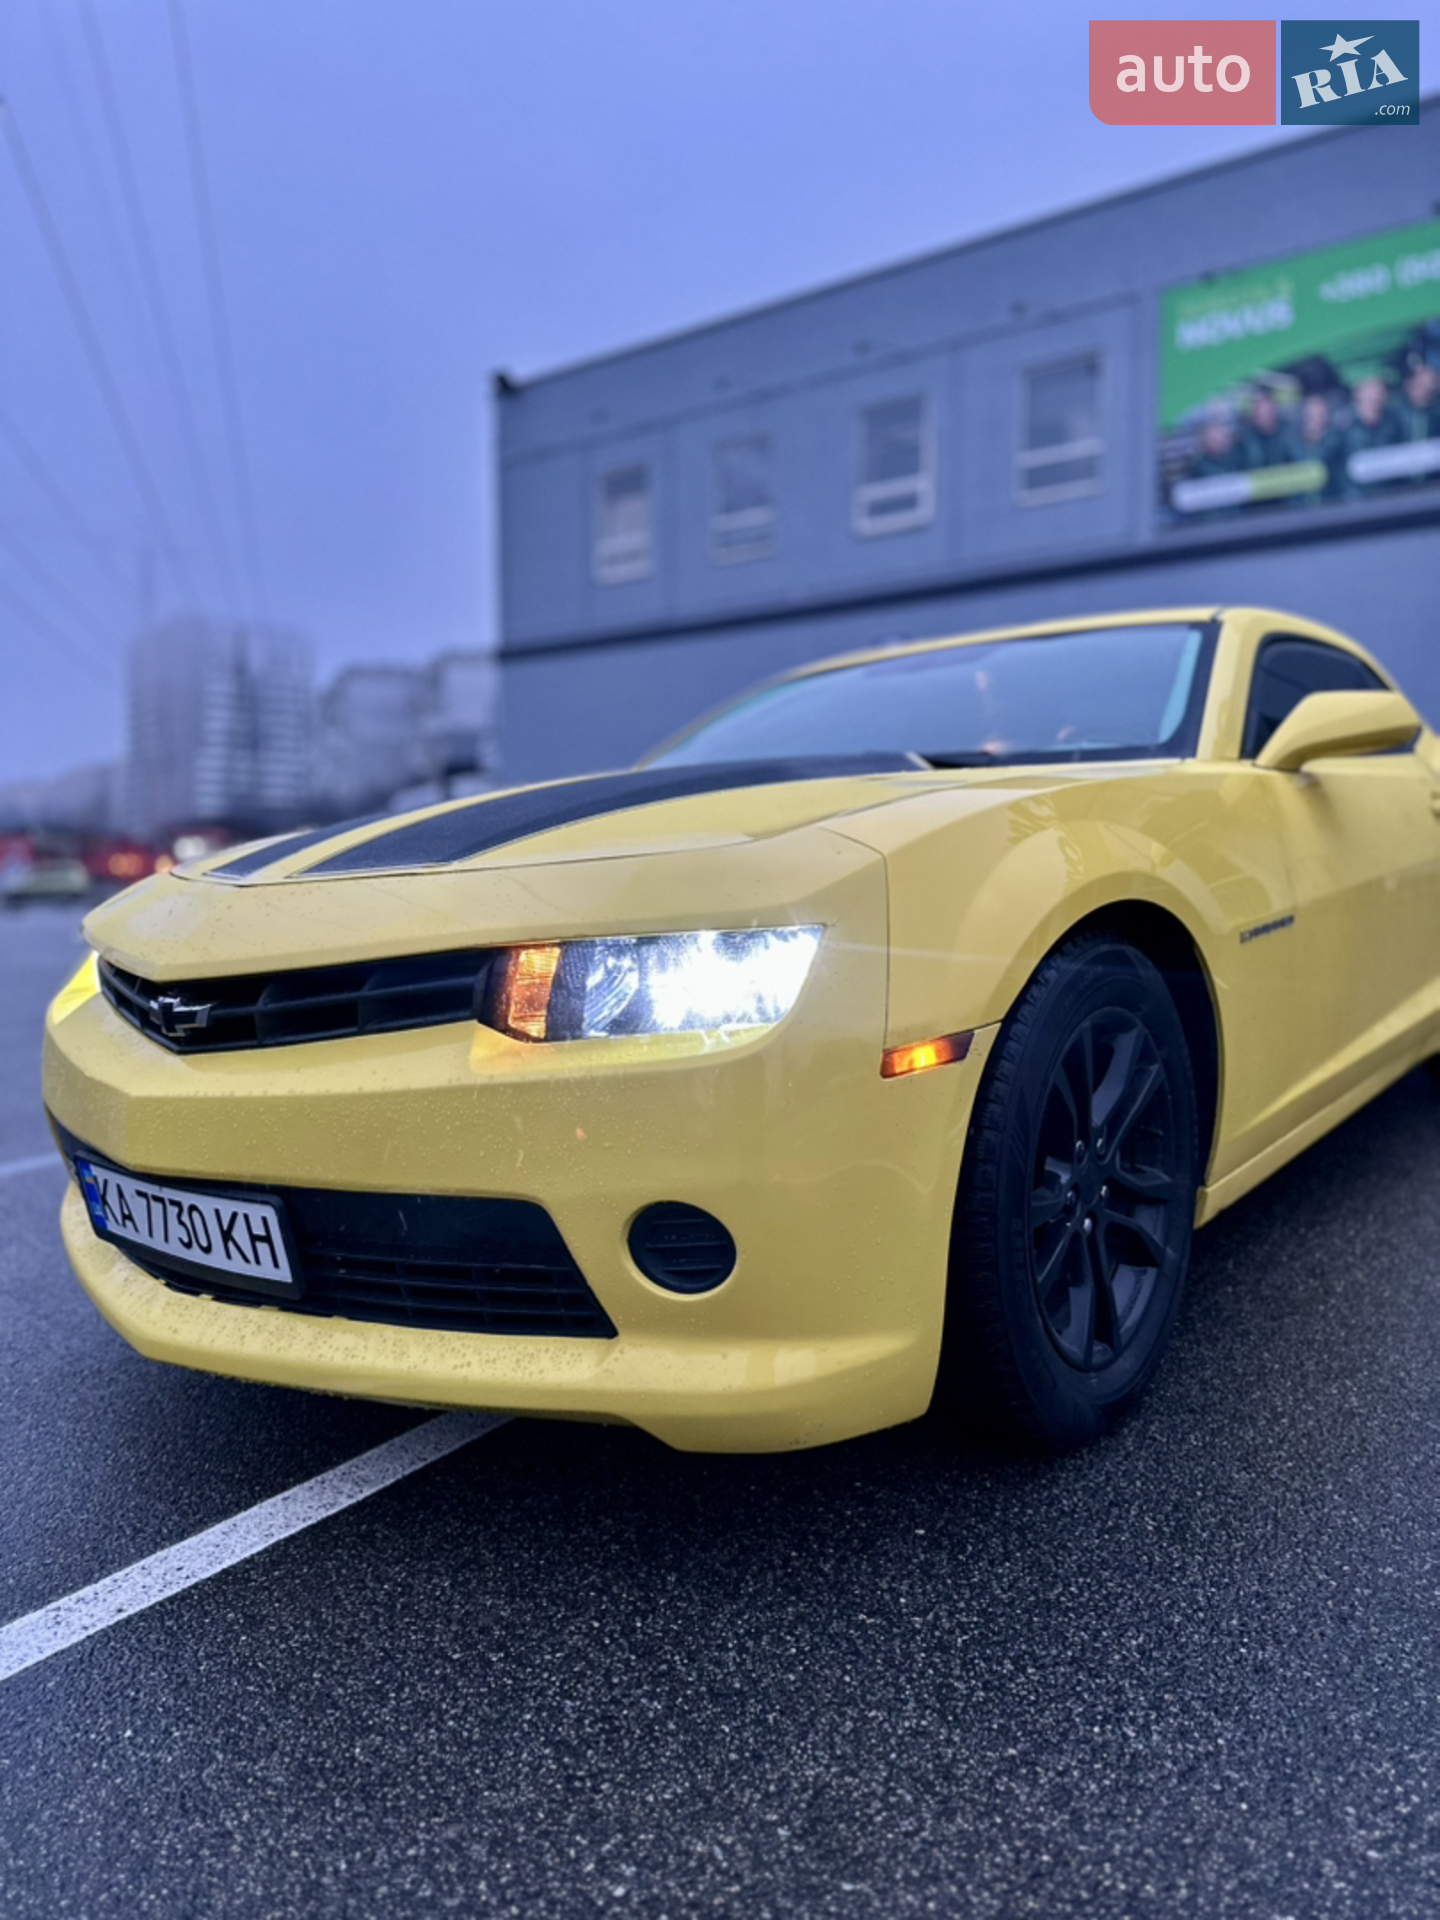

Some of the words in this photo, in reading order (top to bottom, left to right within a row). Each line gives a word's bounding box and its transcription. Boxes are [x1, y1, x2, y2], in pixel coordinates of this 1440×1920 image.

[93, 1174, 140, 1234] KA
[134, 1188, 213, 1255] 7730
[214, 1207, 281, 1270] KH
